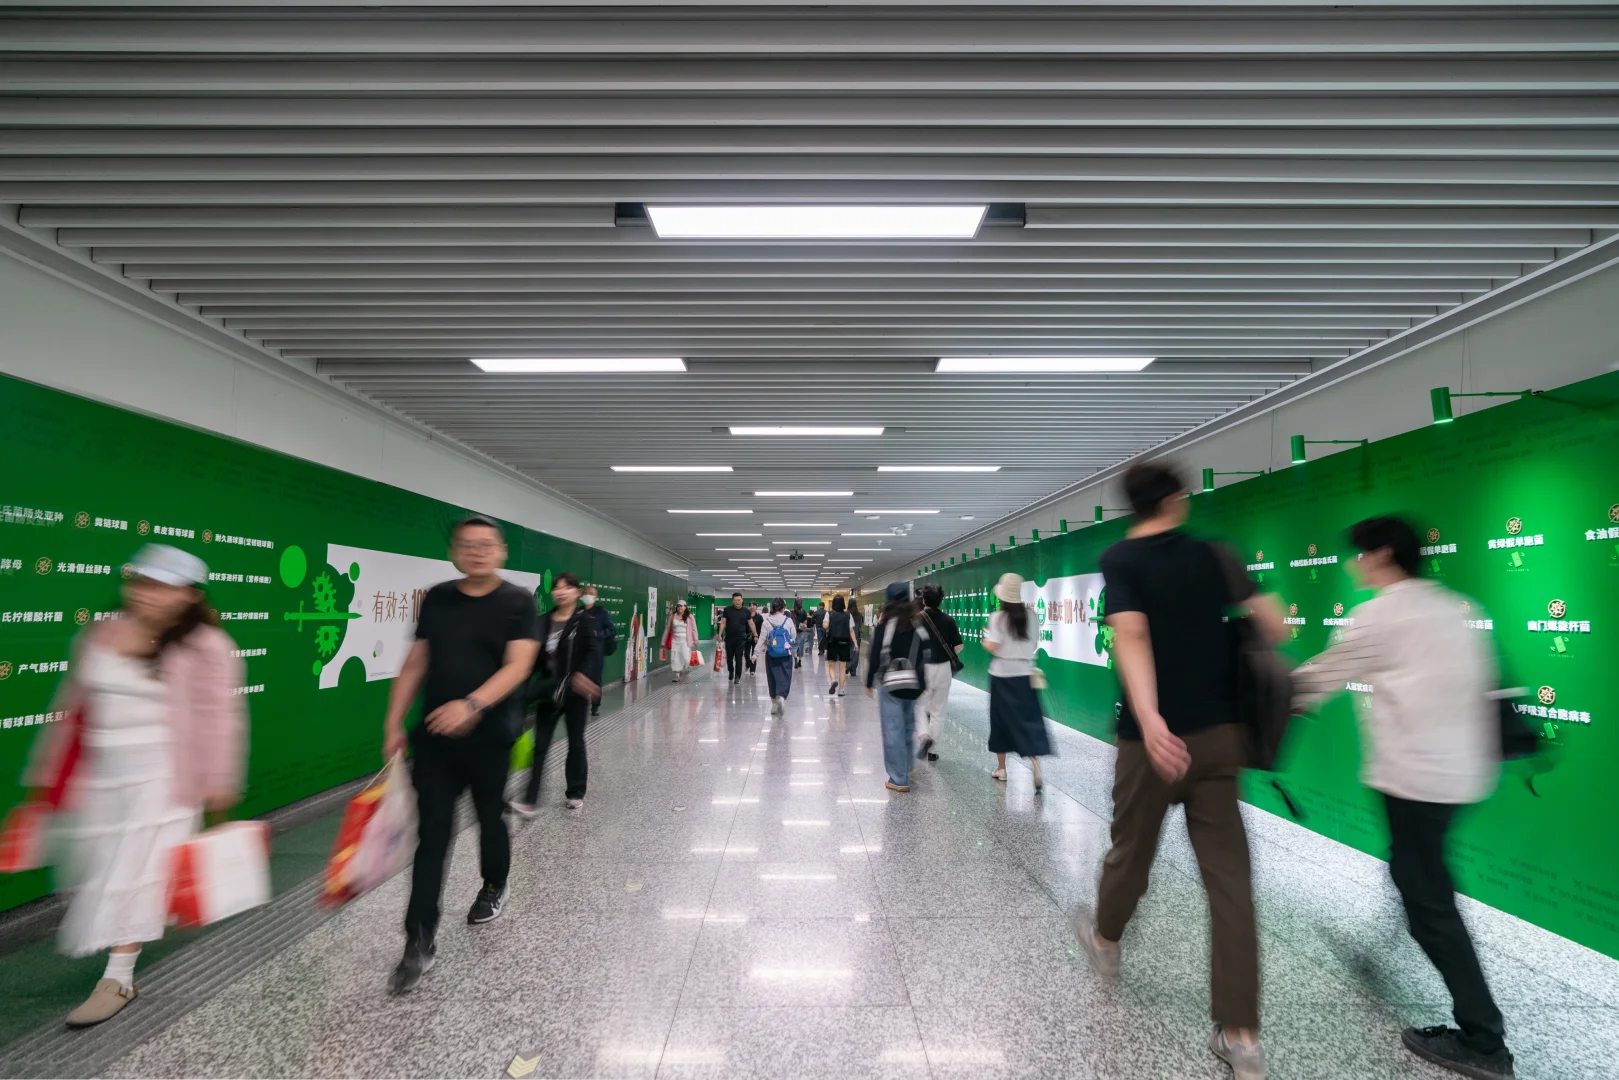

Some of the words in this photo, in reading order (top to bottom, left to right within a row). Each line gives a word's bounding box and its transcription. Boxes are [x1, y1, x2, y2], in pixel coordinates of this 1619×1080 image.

[0, 504, 64, 523] 氏菌肠炎亚种
[94, 517, 128, 531] 粪链球菌
[153, 525, 195, 539] 表皮葡萄球菌
[1487, 534, 1544, 550] 黄绿假单胞菌
[56, 562, 111, 575] 光滑假丝酵母
[0, 611, 63, 622] 氏柠檬酸杆菌
[17, 661, 68, 675] 产气肠杆菌
